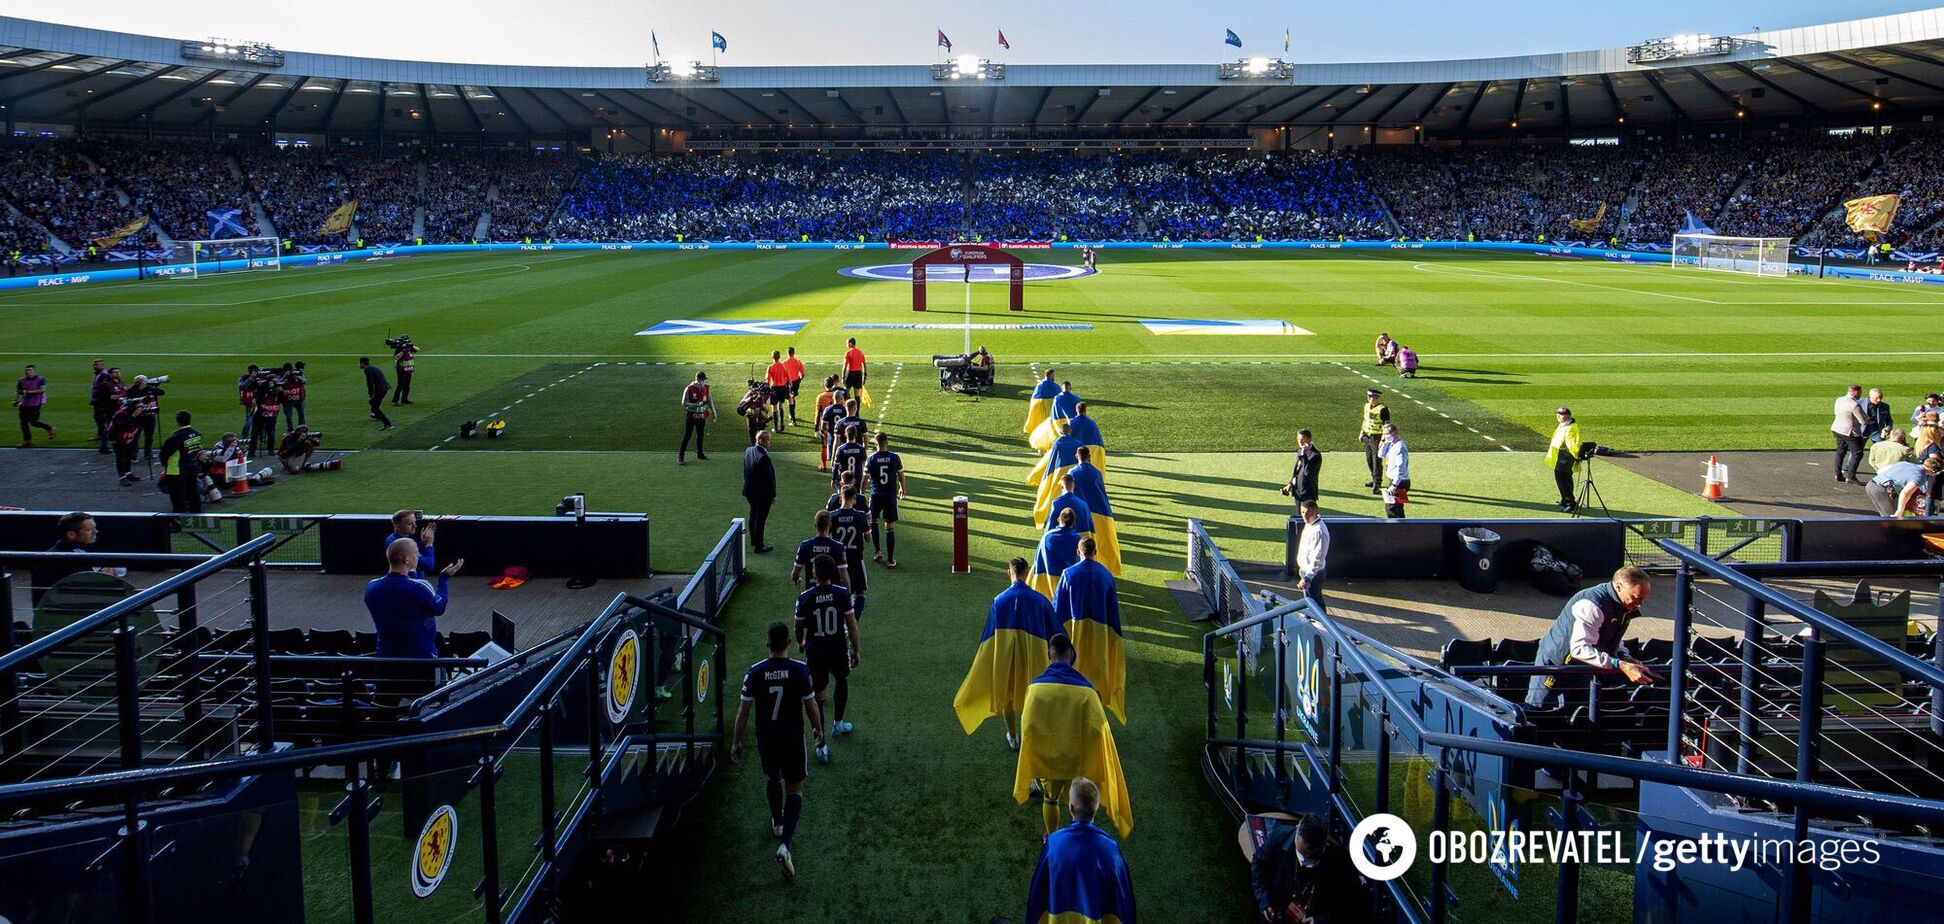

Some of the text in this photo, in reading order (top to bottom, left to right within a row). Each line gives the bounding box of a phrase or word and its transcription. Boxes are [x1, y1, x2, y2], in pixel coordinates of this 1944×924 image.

[38, 276, 90, 286] PEACE МИР
[1870, 273, 1924, 284] PEACE МИР
[848, 456, 856, 473] 8
[880, 466, 888, 484] 5
[837, 526, 858, 549] 22
[816, 594, 833, 603] ADAMS
[814, 606, 838, 636] 10
[764, 670, 789, 680] McGINN
[769, 686, 784, 720] 7
